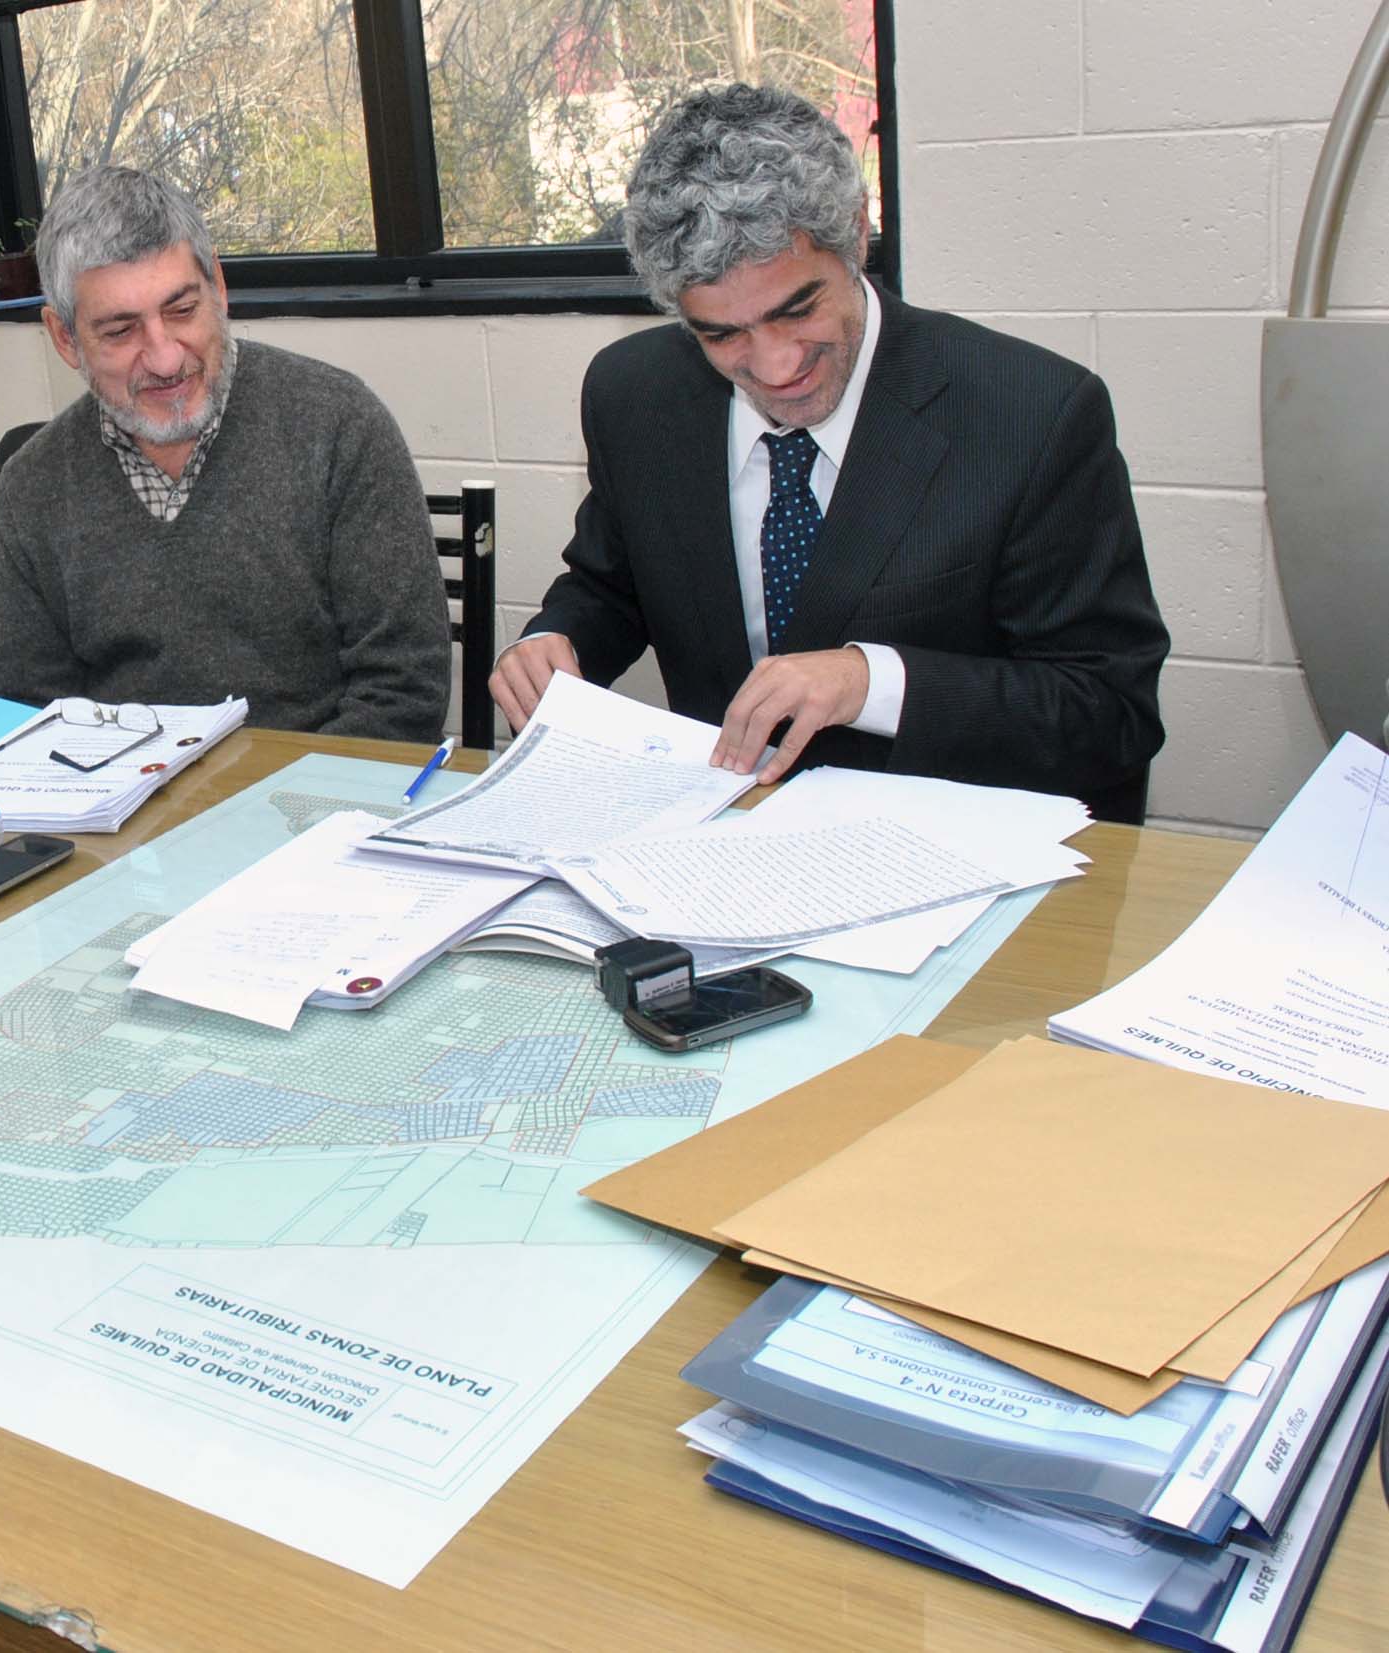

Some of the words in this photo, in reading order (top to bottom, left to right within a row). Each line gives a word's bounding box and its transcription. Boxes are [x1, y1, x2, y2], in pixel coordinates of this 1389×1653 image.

[1362, 910, 1389, 932] CIONES
[1123, 1025, 1206, 1062] QUILMES
[1207, 1057, 1235, 1072] DE
[174, 1286, 304, 1337] TRIBUTARIAS
[90, 1323, 170, 1358] QUILMES
[156, 1328, 234, 1362] HACIENDA
[202, 1330, 252, 1355] Catastro
[253, 1347, 269, 1360] de
[305, 1330, 380, 1360] ZONAS
[852, 1344, 877, 1360] S.A.
[170, 1352, 200, 1368] DE
[234, 1356, 261, 1372] DE
[270, 1354, 320, 1378] General
[379, 1353, 413, 1372] DE
[263, 1364, 367, 1408] SECRETARIA
[321, 1370, 380, 1397] Dirección
[414, 1365, 493, 1398] PLANO
[882, 1355, 997, 1393] construcciones
[900, 1375, 914, 1386] 4
[200, 1362, 354, 1422] MUNICIPALIDAD
[948, 1388, 1028, 1418] Carpeta
[1000, 1389, 1052, 1410] cerros
[1054, 1403, 1077, 1415] los
[1082, 1406, 1106, 1418] De
[1265, 1434, 1291, 1475] RAFER
[1285, 1407, 1308, 1440] office
[1249, 1564, 1277, 1604] RAFER
[1271, 1533, 1293, 1565] office
